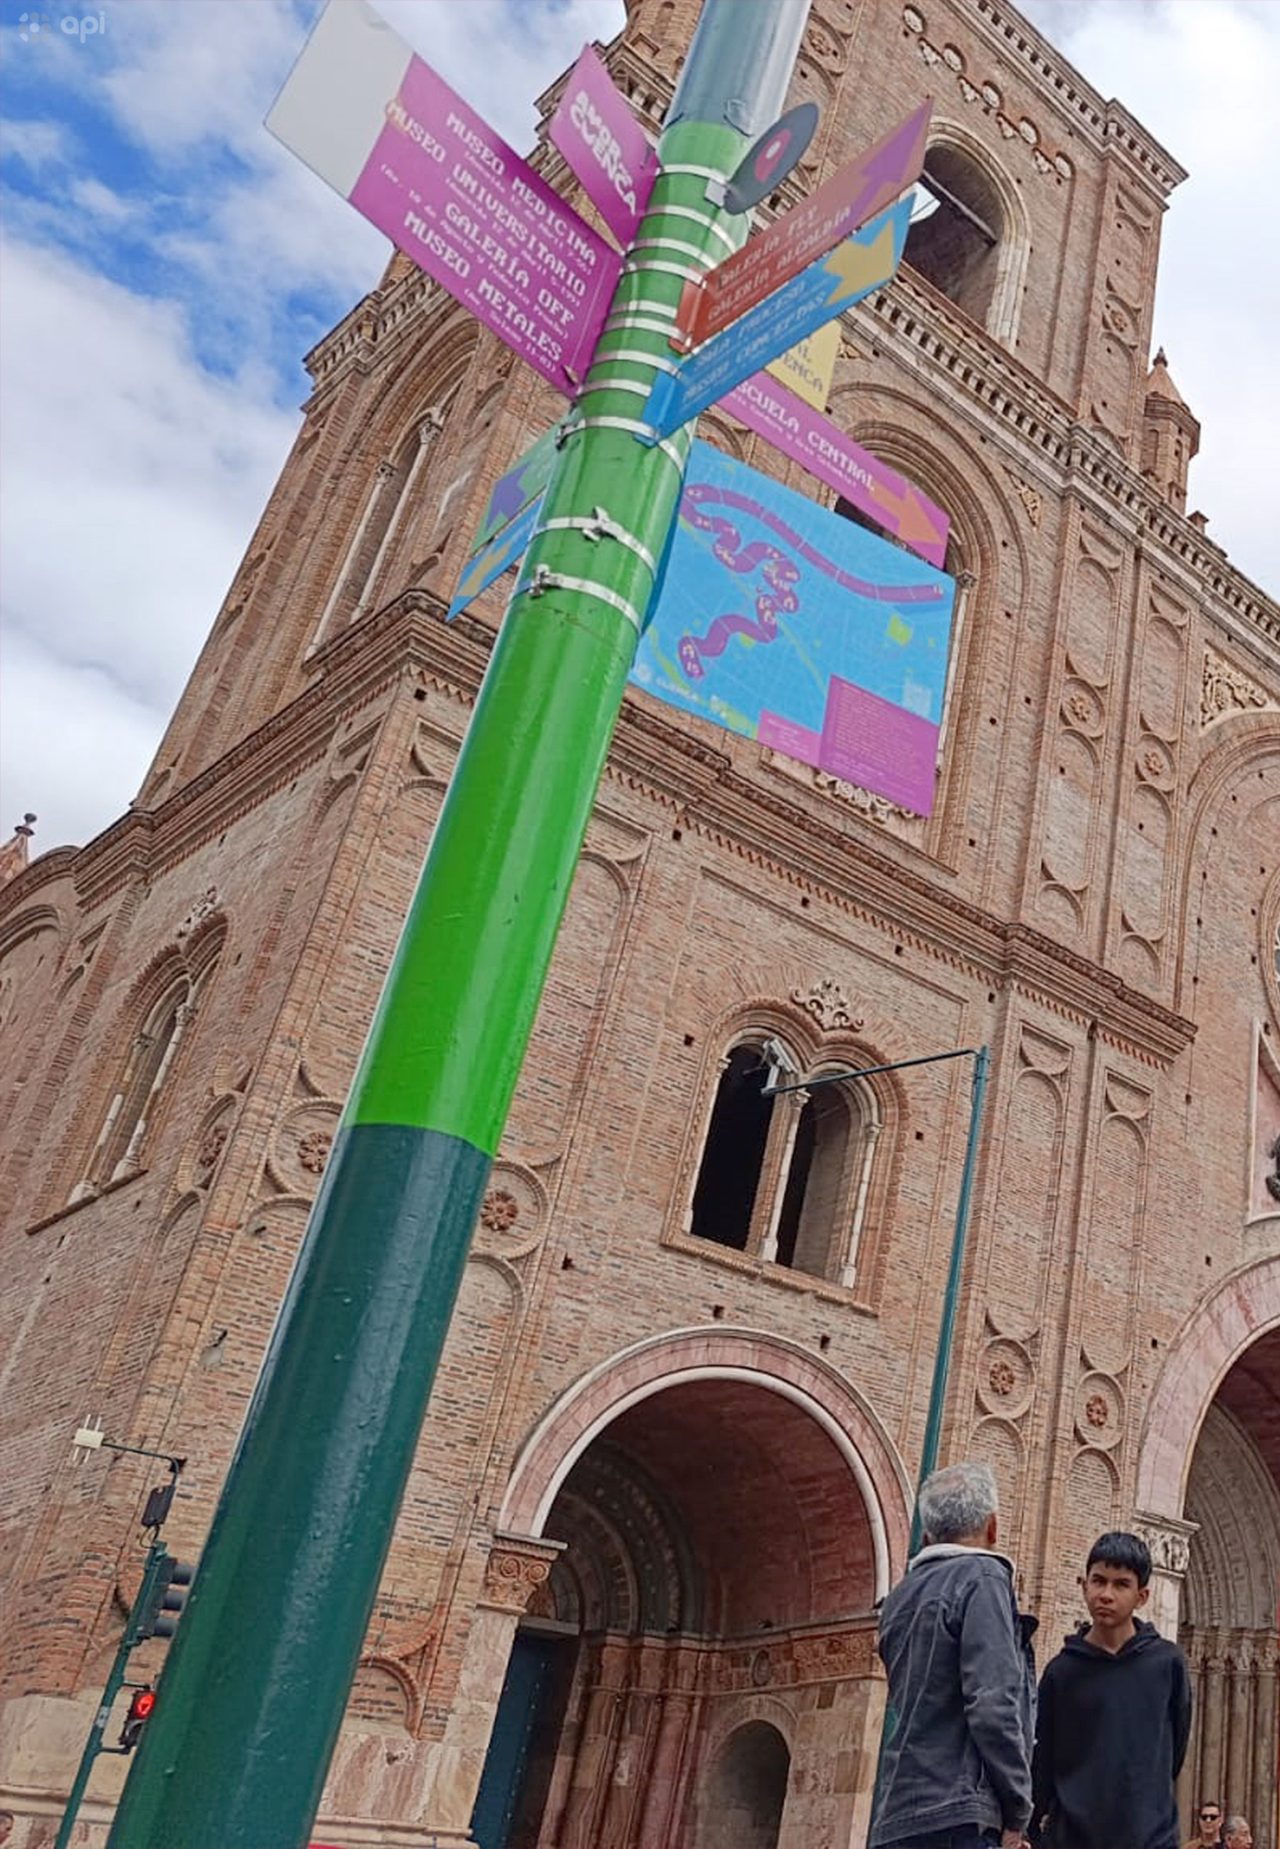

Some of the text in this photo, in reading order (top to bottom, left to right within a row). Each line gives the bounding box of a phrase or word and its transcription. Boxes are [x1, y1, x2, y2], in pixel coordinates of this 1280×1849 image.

[385, 98, 447, 166] MUSEO
[450, 161, 587, 300] UNIVERSITARIO
[444, 109, 598, 268] MUSEO MEDICINA
[569, 103, 637, 216] CUENCA
[401, 207, 563, 364] MUSEO METALES
[442, 195, 576, 332] GALERÍA OFF
[737, 380, 875, 491] SCUELA CENTRAL
[783, 351, 823, 392] ENCA
